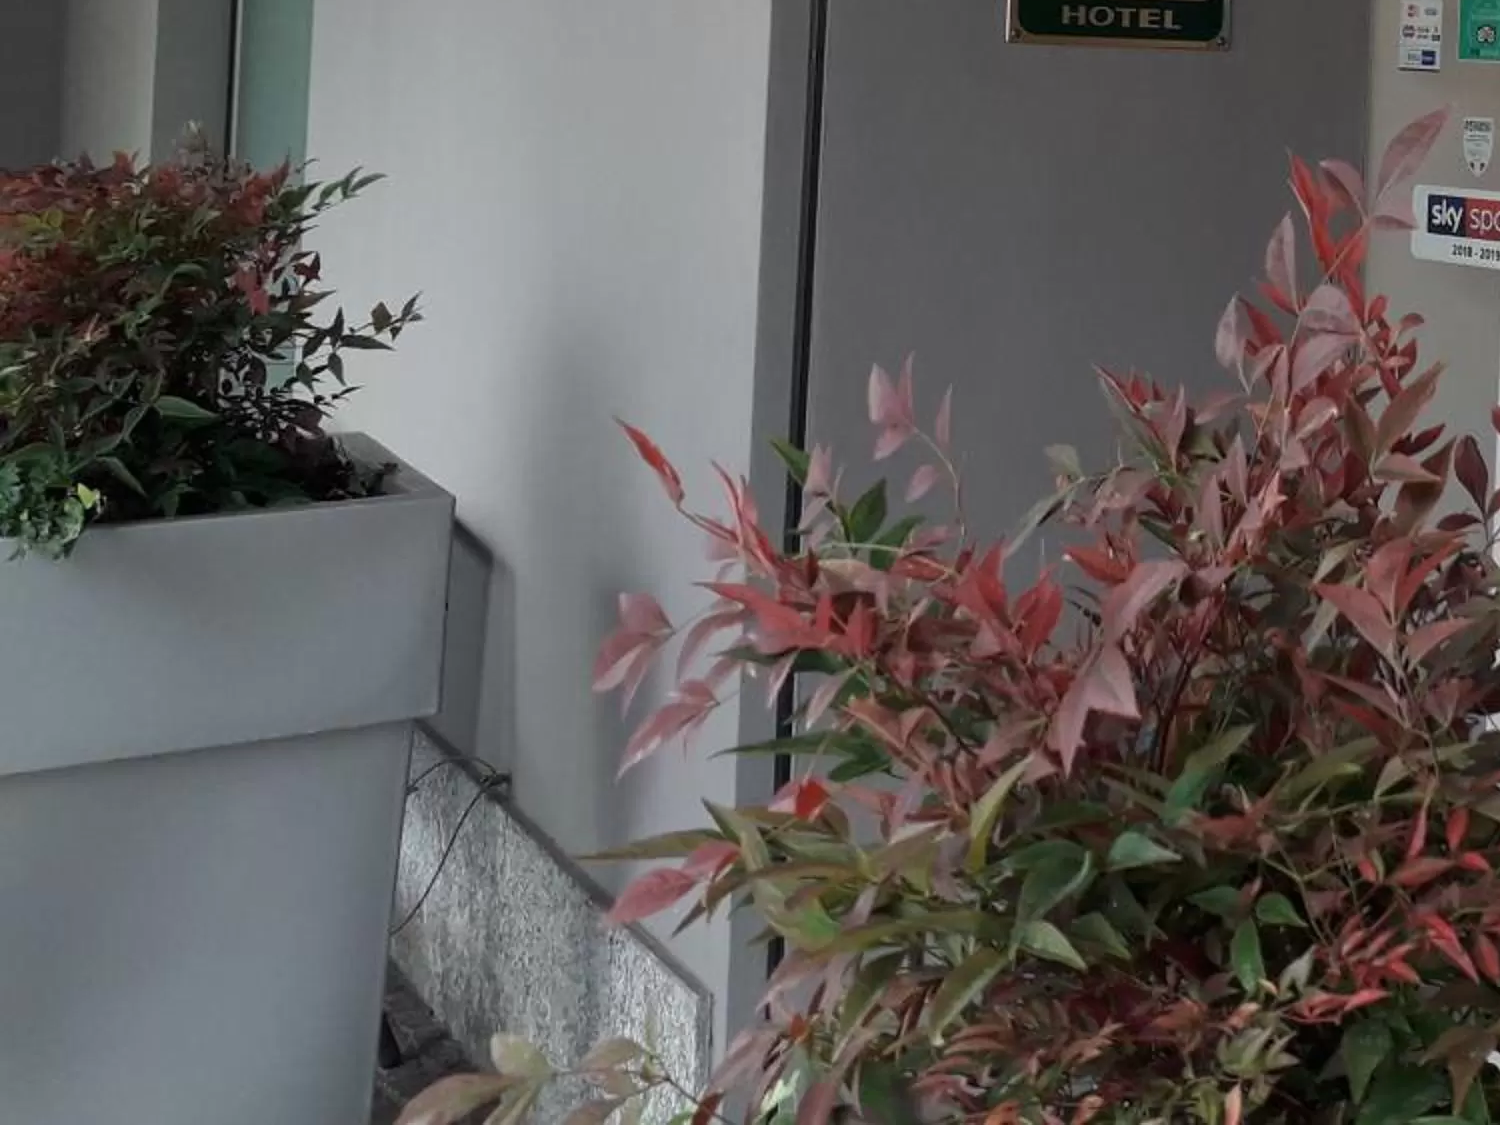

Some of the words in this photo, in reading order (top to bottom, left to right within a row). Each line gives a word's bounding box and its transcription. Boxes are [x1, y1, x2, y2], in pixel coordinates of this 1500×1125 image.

[1061, 4, 1182, 30] HOTEL
[1431, 198, 1463, 233] sky
[1452, 243, 1473, 258] 2018
[1479, 248, 1500, 261] 2019
